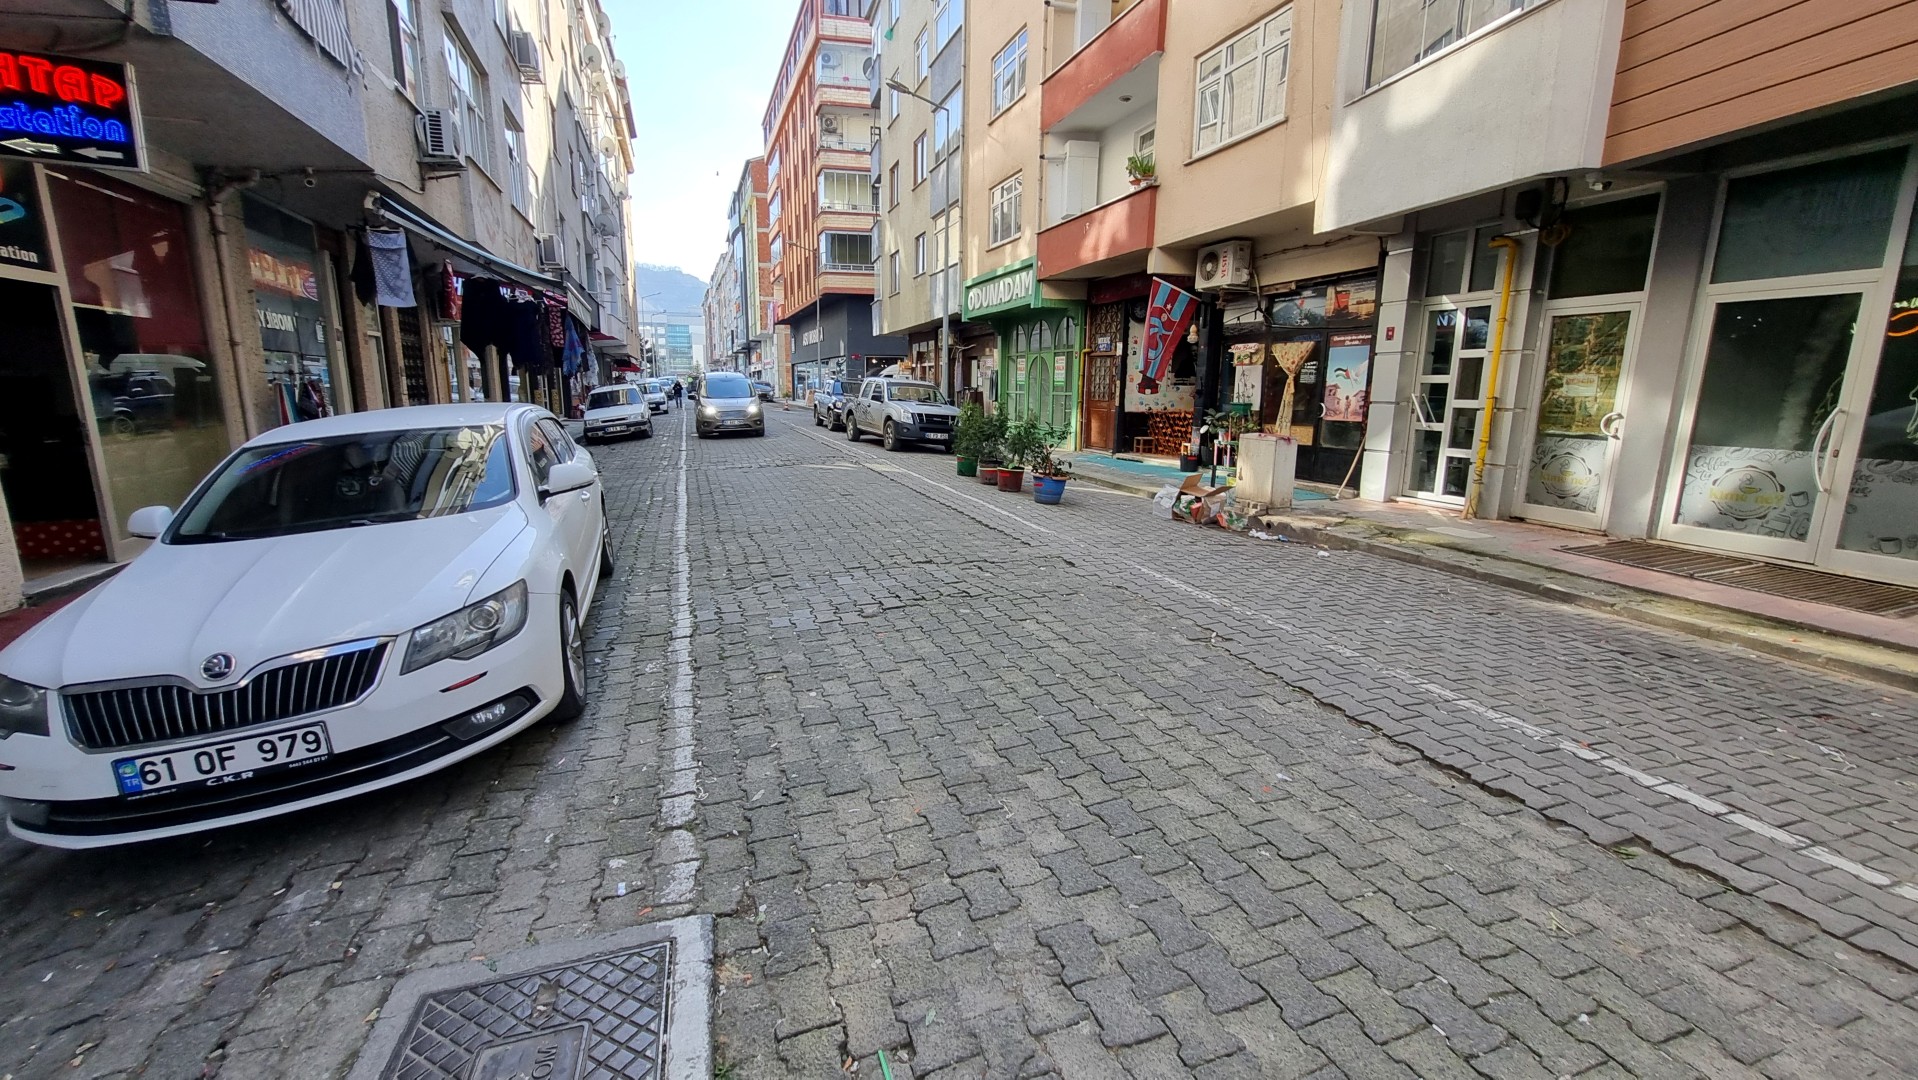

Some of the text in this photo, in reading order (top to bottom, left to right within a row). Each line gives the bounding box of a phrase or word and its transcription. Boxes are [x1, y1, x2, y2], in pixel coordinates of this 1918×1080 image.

[968, 270, 1032, 311] ODUNADAM
[139, 757, 177, 785] 61
[194, 746, 235, 775] OF
[257, 731, 321, 762] 979
[125, 778, 140, 787] TR
